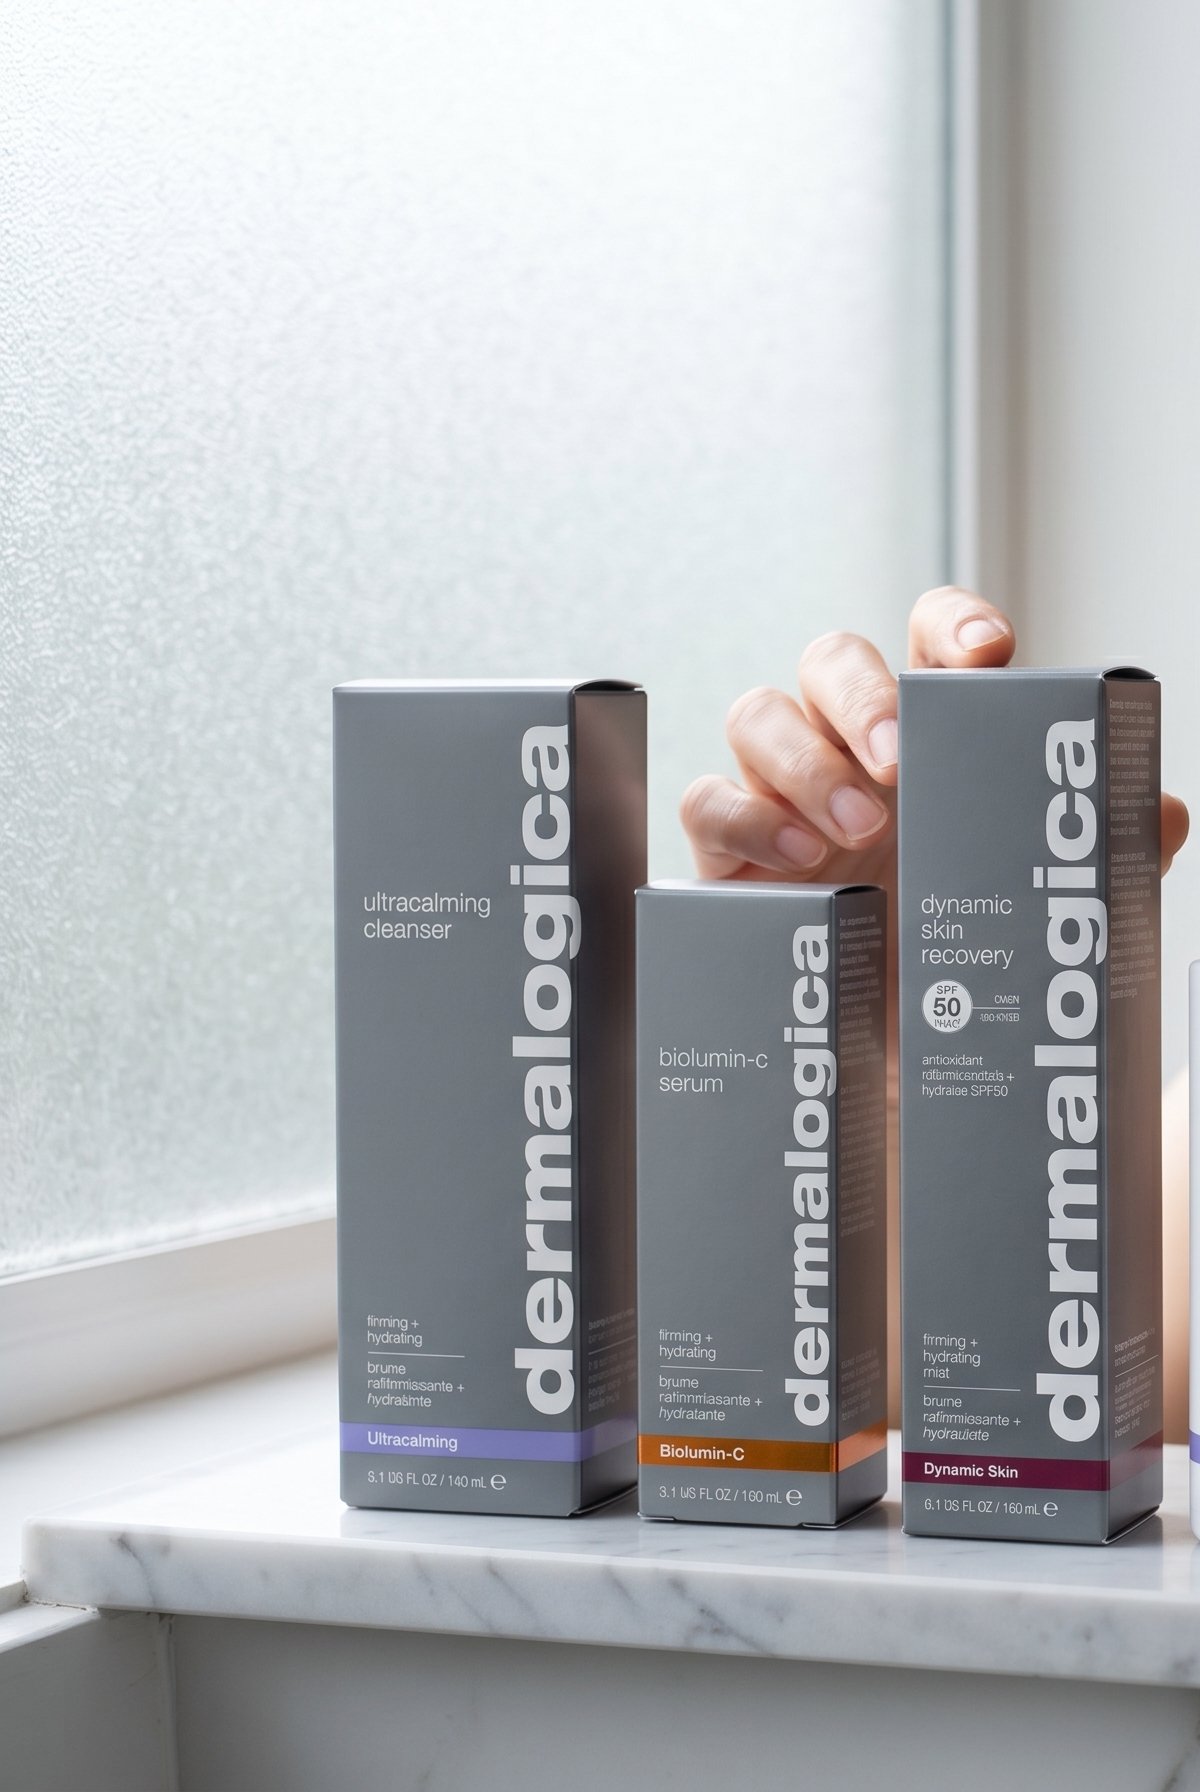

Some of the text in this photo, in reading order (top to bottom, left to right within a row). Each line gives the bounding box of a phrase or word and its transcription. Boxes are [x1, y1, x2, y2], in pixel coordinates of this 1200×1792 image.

[363, 891, 491, 918] ultracalming
[921, 893, 1013, 918] dynamic
[363, 918, 452, 939] cleanser
[921, 919, 963, 940] skin
[921, 947, 1014, 970] recovery
[936, 985, 958, 995] SPF
[933, 997, 961, 1016] 50
[659, 1047, 768, 1069] biolumin-c
[922, 1054, 984, 1066] antioxidant
[510, 724, 582, 1415] dermalogica
[659, 1075, 723, 1093] serum
[1033, 718, 1107, 1443] dermalogica
[971, 1086, 1009, 1097] SPF50
[784, 923, 837, 1426] dermalogica
[367, 1331, 423, 1347] hydrating
[659, 1328, 702, 1345] firming
[923, 1333, 966, 1350] firming
[659, 1344, 716, 1362] hydrating
[923, 1349, 981, 1367] hydrating
[367, 1361, 406, 1375] brume
[658, 1406, 726, 1422] hydratante
[367, 1431, 458, 1452] Ultracalming
[659, 1443, 745, 1461] Biolumin-C
[924, 1462, 1018, 1478] Dynamic Skin
[407, 1473, 420, 1485] FL
[422, 1473, 437, 1486] OZ
[448, 1475, 469, 1488] 140
[471, 1476, 487, 1489] mL
[699, 1487, 713, 1500] FL
[715, 1488, 731, 1501] OZ
[742, 1489, 763, 1502] 160
[766, 1491, 782, 1504] mL
[962, 1500, 976, 1512] FL
[977, 1501, 993, 1513] OZ
[1003, 1502, 1023, 1515] 160
[1025, 1503, 1040, 1515] mL
